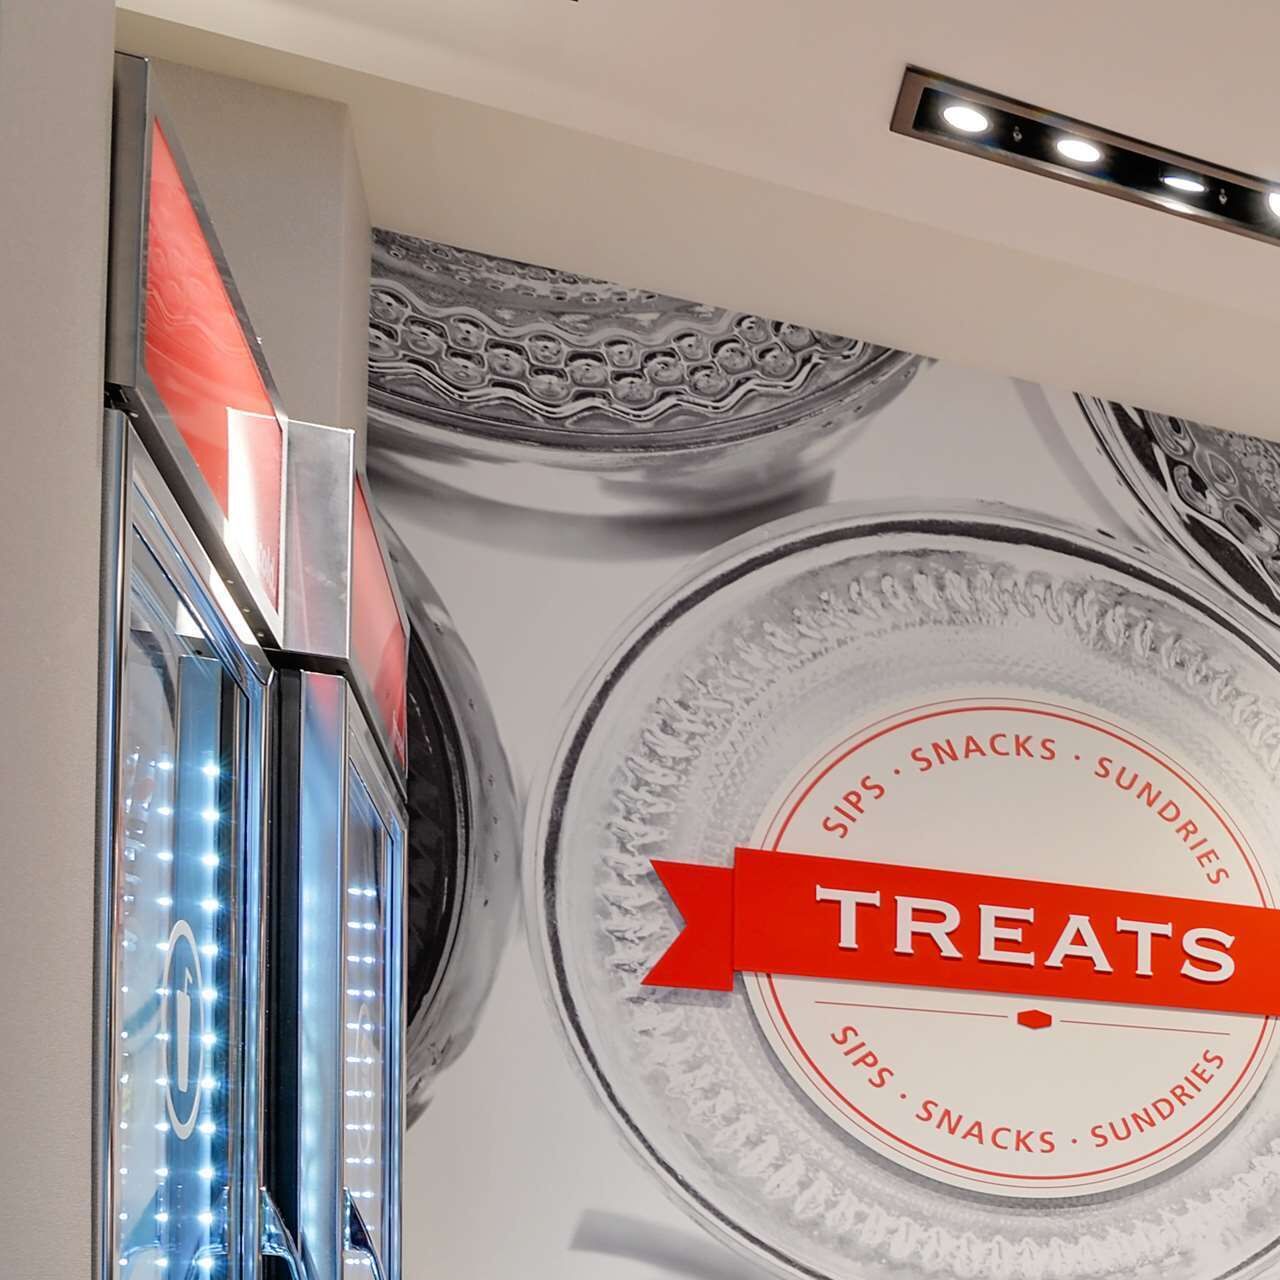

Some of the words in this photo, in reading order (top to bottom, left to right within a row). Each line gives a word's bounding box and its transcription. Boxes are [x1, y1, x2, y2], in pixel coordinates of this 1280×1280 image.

[822, 774, 886, 840] SIPS
[910, 732, 1058, 773] SNACKS
[1094, 755, 1230, 887] SUNDRIES
[815, 884, 1237, 983] TREATS
[830, 1025, 894, 1091] SIPS
[915, 1099, 1056, 1155] SNACKS
[1090, 1050, 1224, 1149] SUNDRIES
